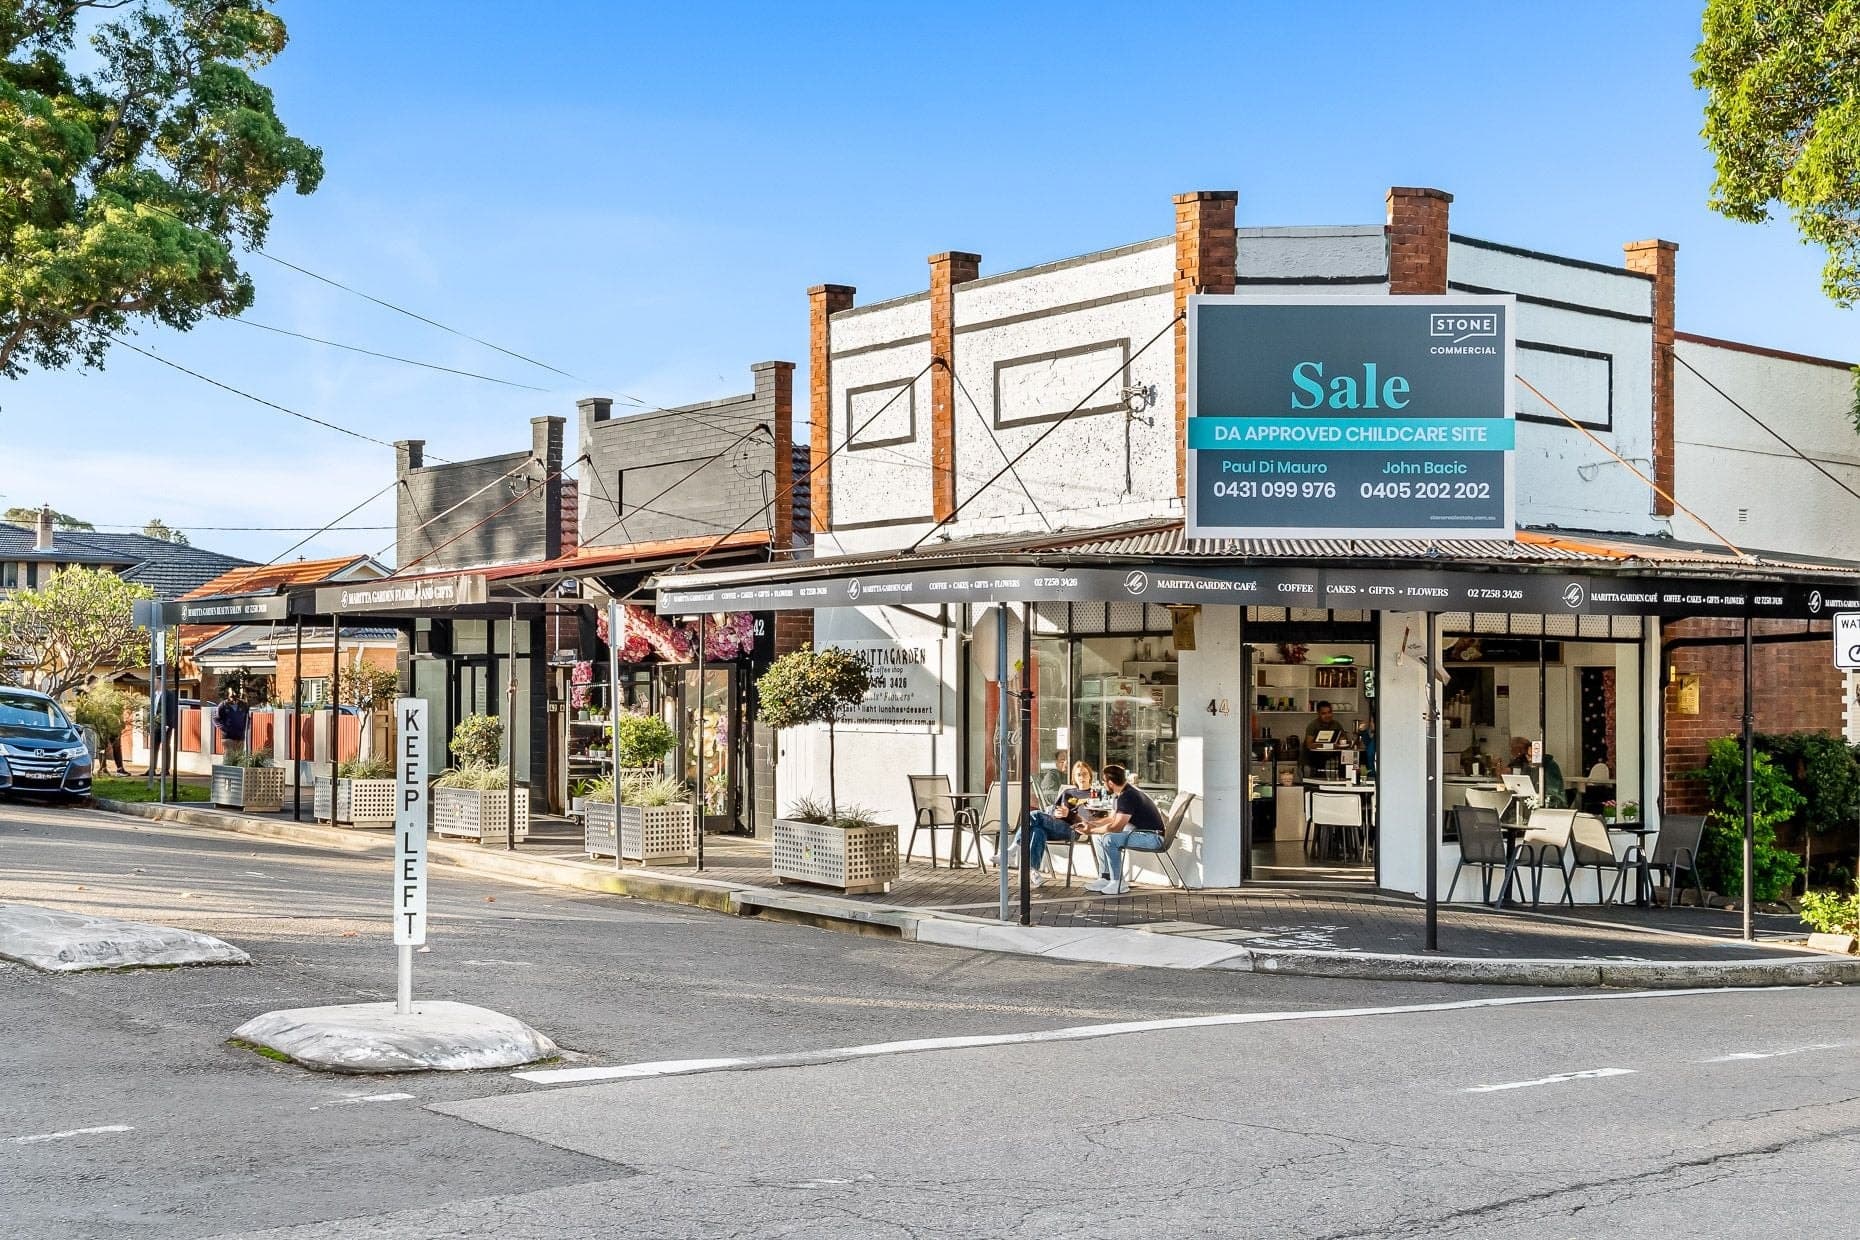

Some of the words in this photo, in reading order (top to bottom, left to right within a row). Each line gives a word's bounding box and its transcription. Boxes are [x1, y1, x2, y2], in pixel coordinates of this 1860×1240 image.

[1437, 319, 1491, 331] STONE
[1430, 346, 1496, 355] COMMERCIAL
[1291, 361, 1410, 410] Sale
[1214, 426, 1241, 442] DA
[1244, 426, 1342, 442] APPROVED
[1345, 426, 1448, 442] CHILDCARE
[1451, 427, 1487, 442] SITE
[1222, 460, 1257, 474] Paul
[1259, 460, 1274, 474] Di
[1276, 461, 1328, 474] Mauro
[1382, 461, 1422, 475] John
[1424, 461, 1467, 475] Bacic
[1213, 481, 1257, 498] 0431
[1261, 481, 1298, 498] 099
[1301, 481, 1336, 499] 976
[1360, 482, 1411, 499] 0405
[1414, 483, 1452, 499] 202
[1454, 483, 1490, 499] 202
[929, 582, 947, 590] COFFEE
[953, 581, 968, 589] CAKES
[974, 581, 988, 589] GIFTS
[995, 580, 1020, 588] FLOWERS
[1034, 579, 1042, 587] 02
[1157, 580, 1194, 590] MARITTA
[1196, 581, 1232, 590] GARDEN
[1234, 581, 1256, 591] CAFÉ
[1278, 584, 1314, 592] COFFEE
[1326, 585, 1356, 594] CAKES
[1368, 586, 1394, 595] GIFTS
[1407, 588, 1448, 596] FLOWERS
[1468, 589, 1478, 598] 02
[1480, 589, 1500, 598] 7258
[1502, 590, 1523, 598] 3426
[1591, 592, 1619, 601] MARITTA
[1620, 593, 1644, 602] GARDEN
[1646, 592, 1658, 602] CAFÉ
[1664, 594, 1681, 602] COFFEE
[1724, 597, 1744, 605] FLOWERS
[754, 619, 764, 636] 42
[874, 666, 890, 674] coffee
[890, 678, 907, 688] 3426
[879, 705, 903, 713] lunches
[1207, 699, 1229, 716] 44
[405, 708, 420, 812] KEEP
[403, 832, 418, 935] LEFT
